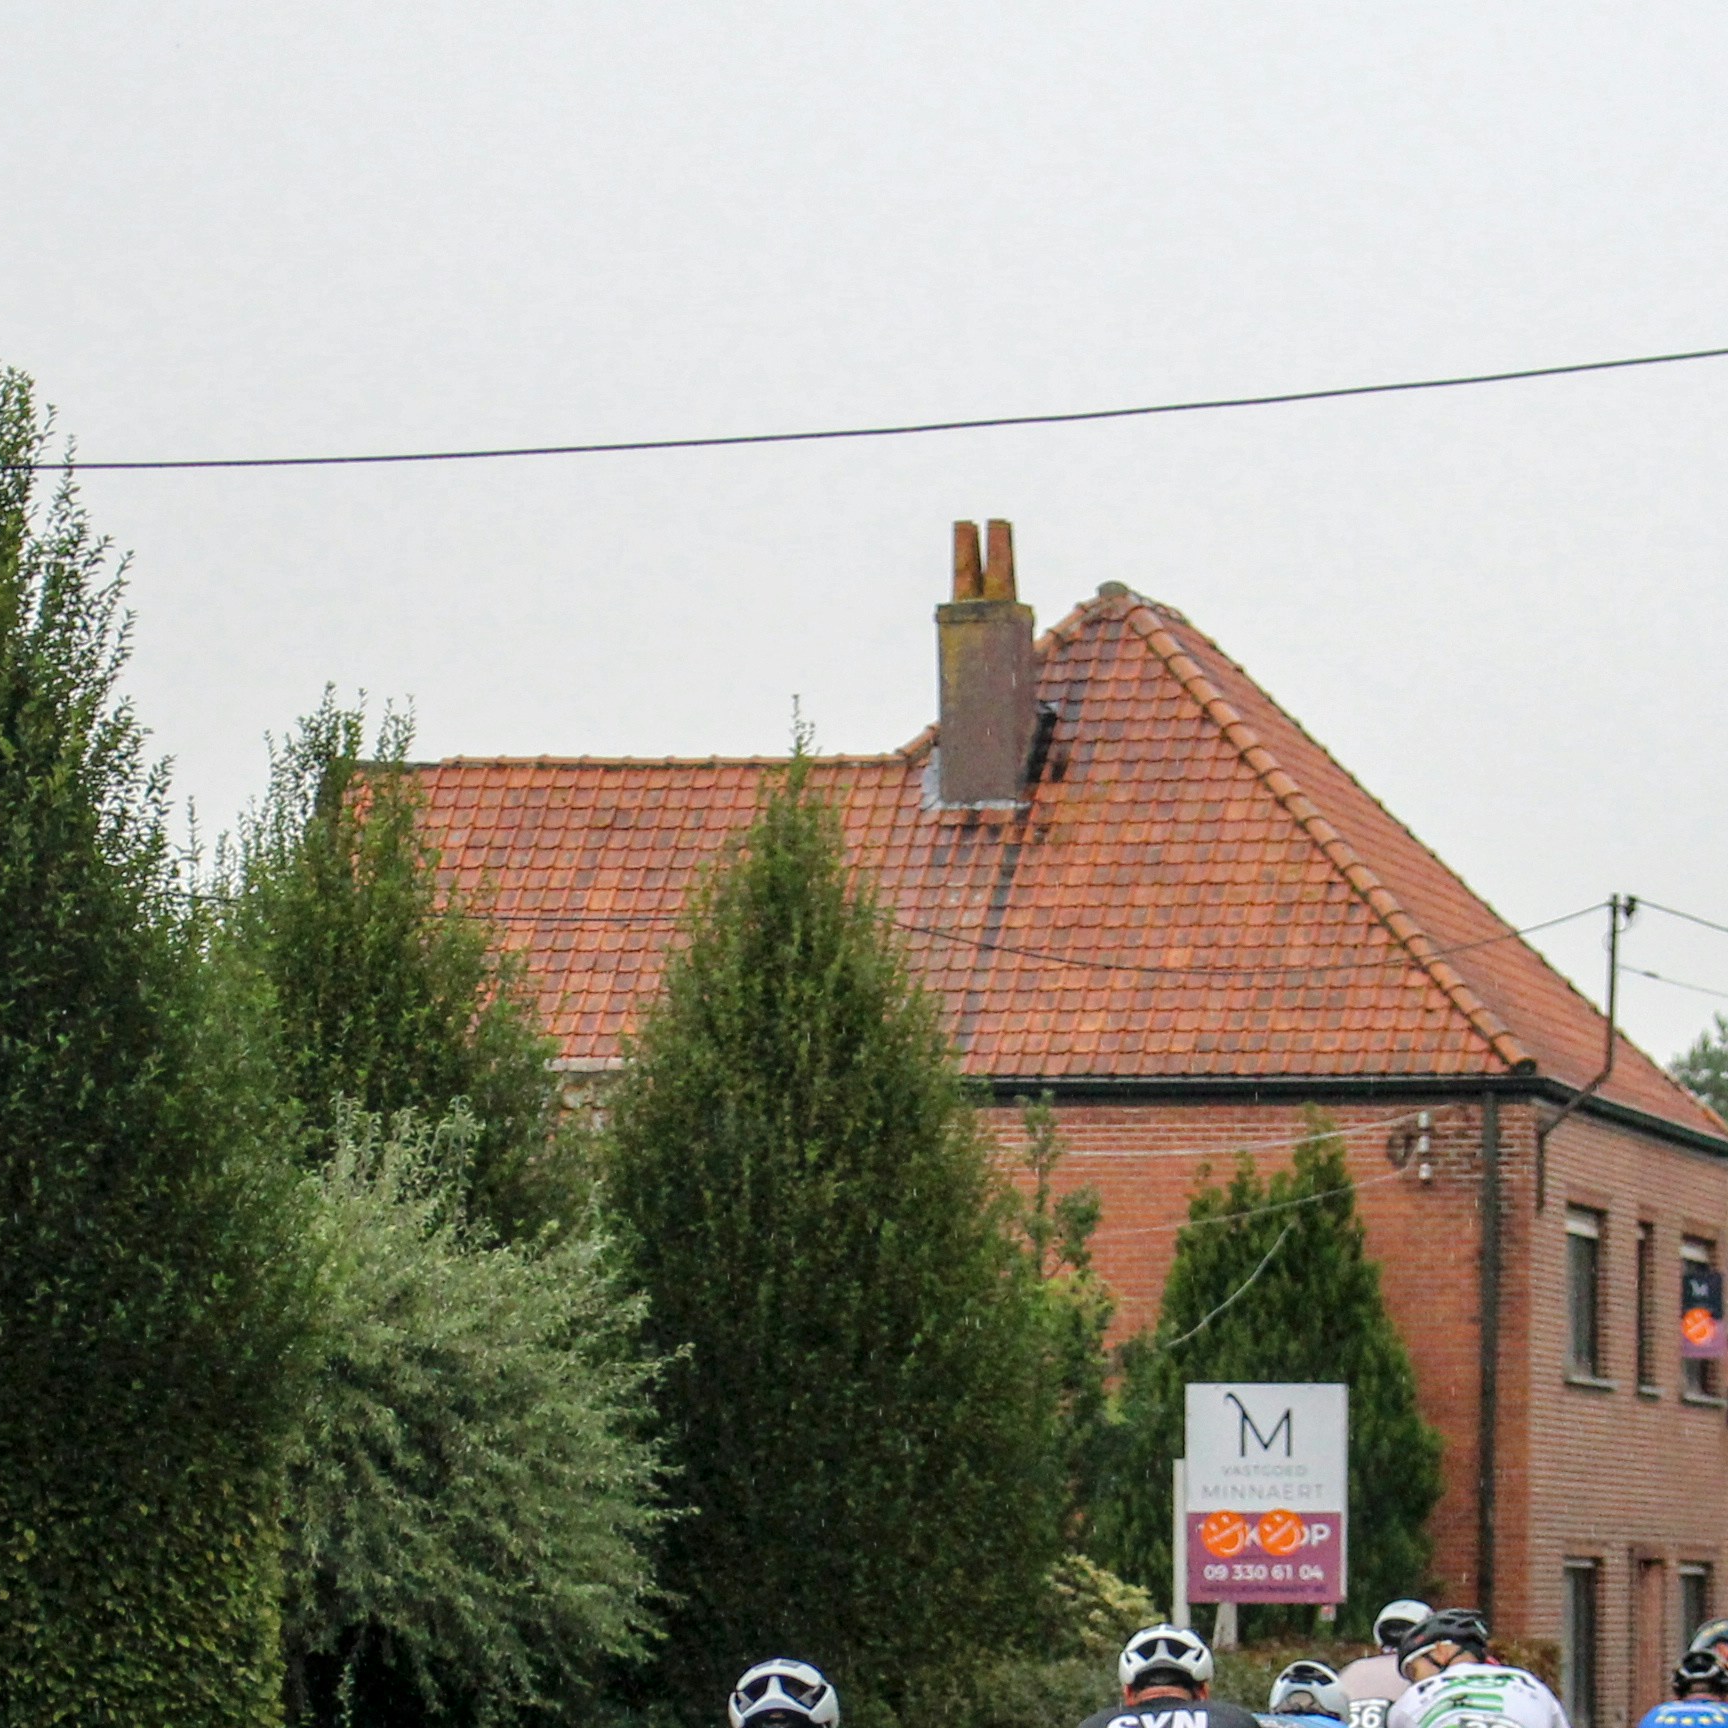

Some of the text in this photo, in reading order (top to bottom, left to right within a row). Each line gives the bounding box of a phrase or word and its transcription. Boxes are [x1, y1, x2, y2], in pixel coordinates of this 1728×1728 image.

[1202, 1483, 1324, 1500] MINNAERT
[1203, 1563, 1325, 1581] 09 330 61 04
